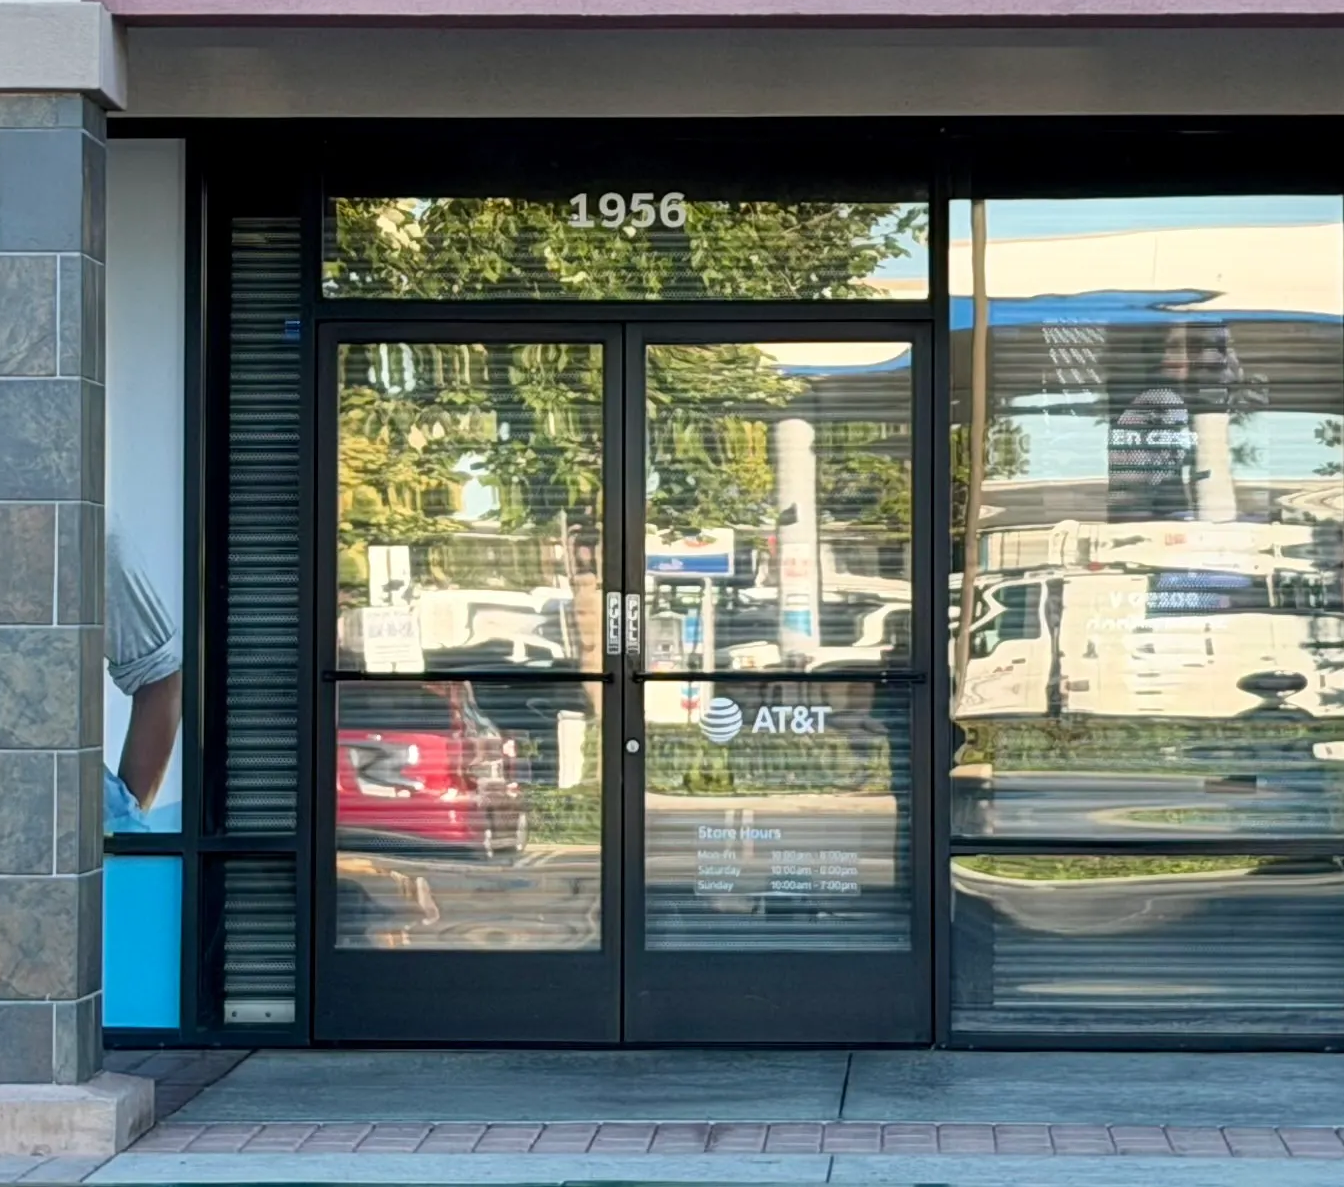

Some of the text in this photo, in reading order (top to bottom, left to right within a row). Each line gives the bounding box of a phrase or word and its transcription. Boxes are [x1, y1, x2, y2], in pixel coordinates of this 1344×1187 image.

[567, 191, 688, 228] 1956
[609, 597, 618, 640] PULL
[627, 599, 638, 642] PULL
[751, 705, 833, 734] AT&T
[697, 825, 781, 840] Store Hours
[697, 865, 741, 878] Saturday
[697, 880, 734, 892] Sunday
